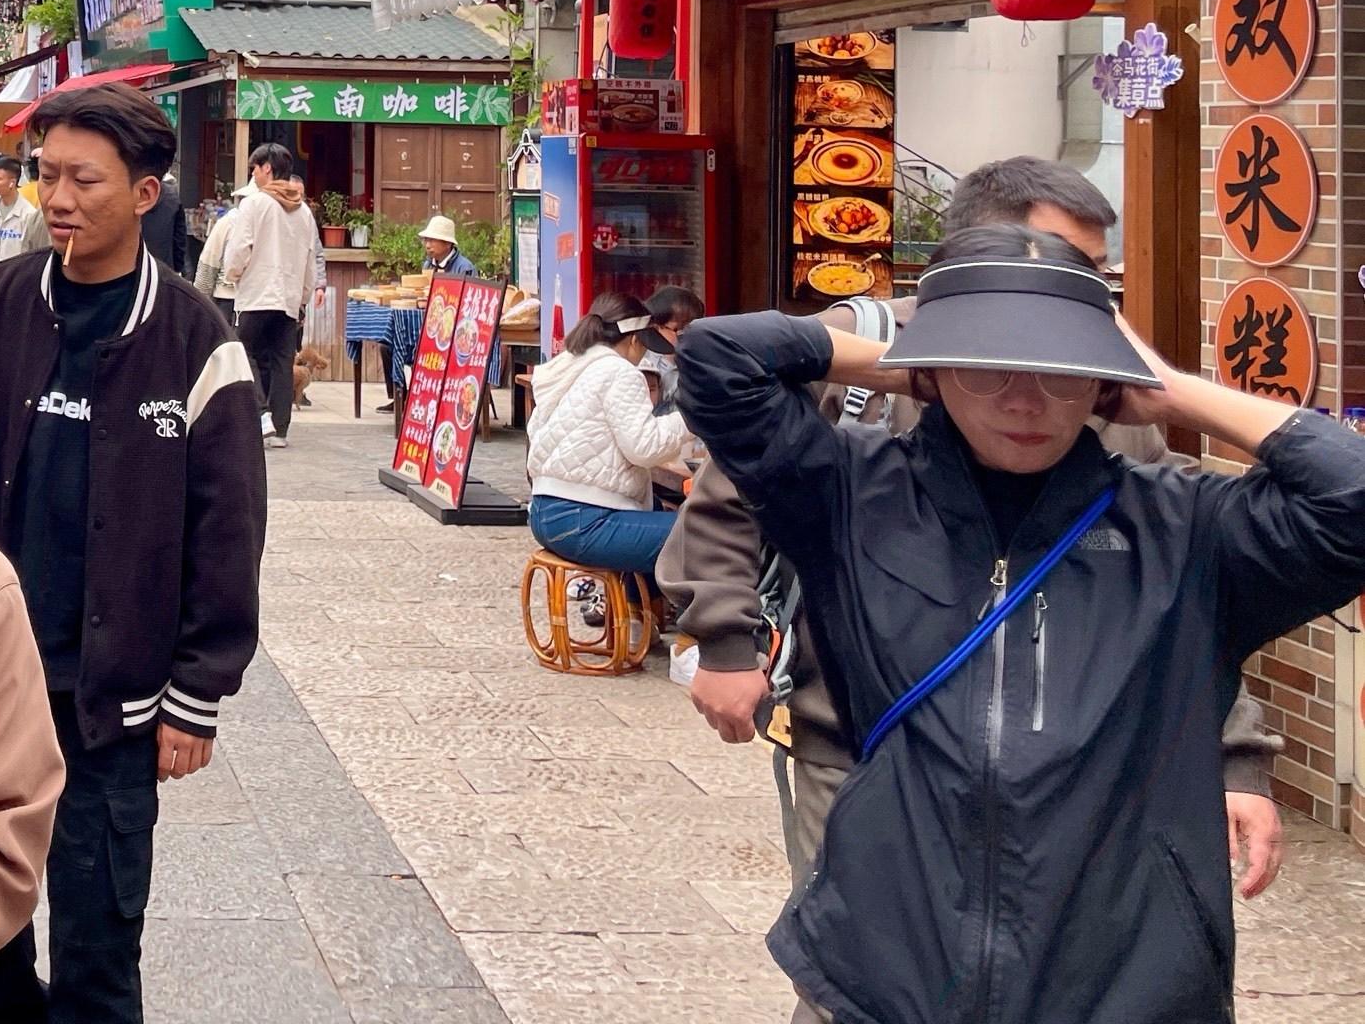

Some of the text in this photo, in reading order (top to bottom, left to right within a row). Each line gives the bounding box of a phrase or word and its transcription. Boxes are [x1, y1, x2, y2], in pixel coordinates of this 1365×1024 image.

[1110, 56, 1159, 75] 茶马花街
[281, 84, 471, 122] 云南咖啡
